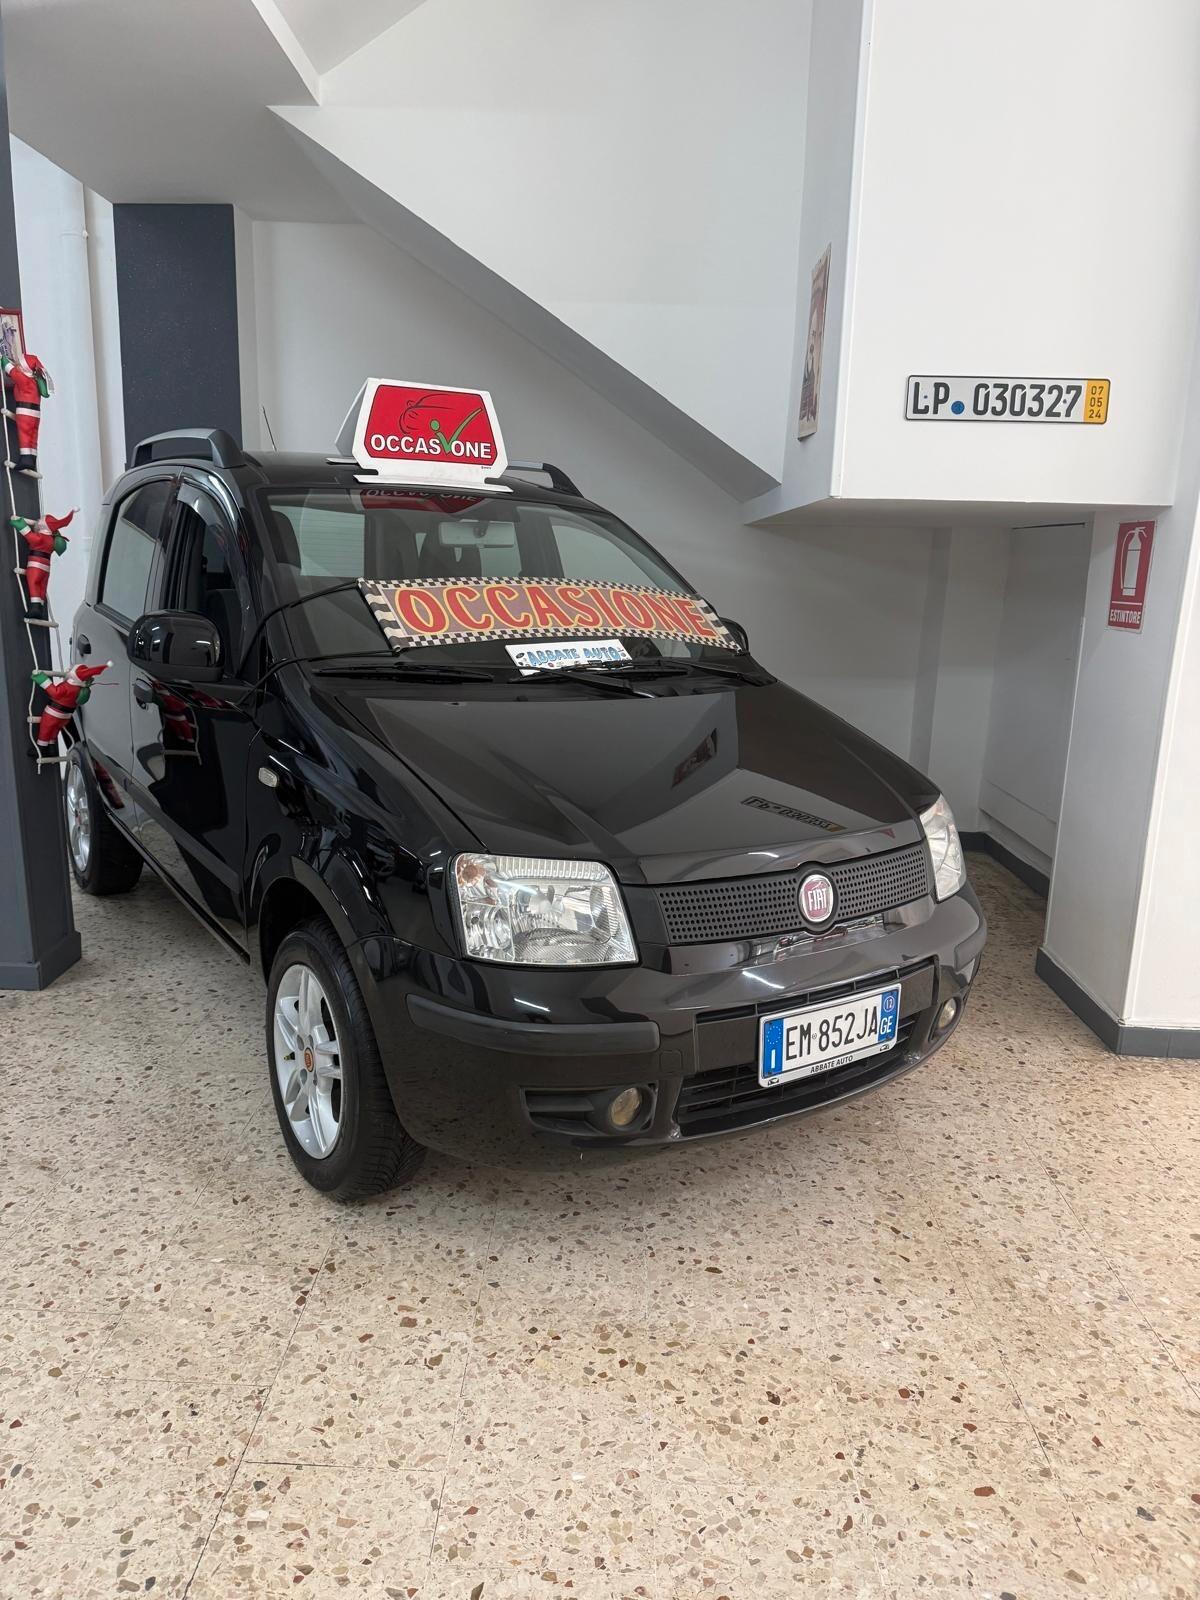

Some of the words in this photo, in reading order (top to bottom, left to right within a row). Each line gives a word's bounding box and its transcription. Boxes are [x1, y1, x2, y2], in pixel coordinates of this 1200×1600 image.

[912, 381, 950, 415] LP
[972, 383, 1083, 418] 030327
[1090, 386, 1104, 396] 07
[1089, 397, 1103, 408] 05
[1088, 408, 1102, 419] 24
[395, 584, 719, 638] OCCASIONE
[1110, 609, 1142, 624] ESTINTORE
[526, 647, 581, 667] ABBATE
[583, 646, 622, 661] AUTO
[808, 888, 827, 911] FIAT
[880, 1015, 893, 1035] GE
[810, 1060, 836, 1074] ABBATE
[836, 1055, 854, 1066] AUTO
